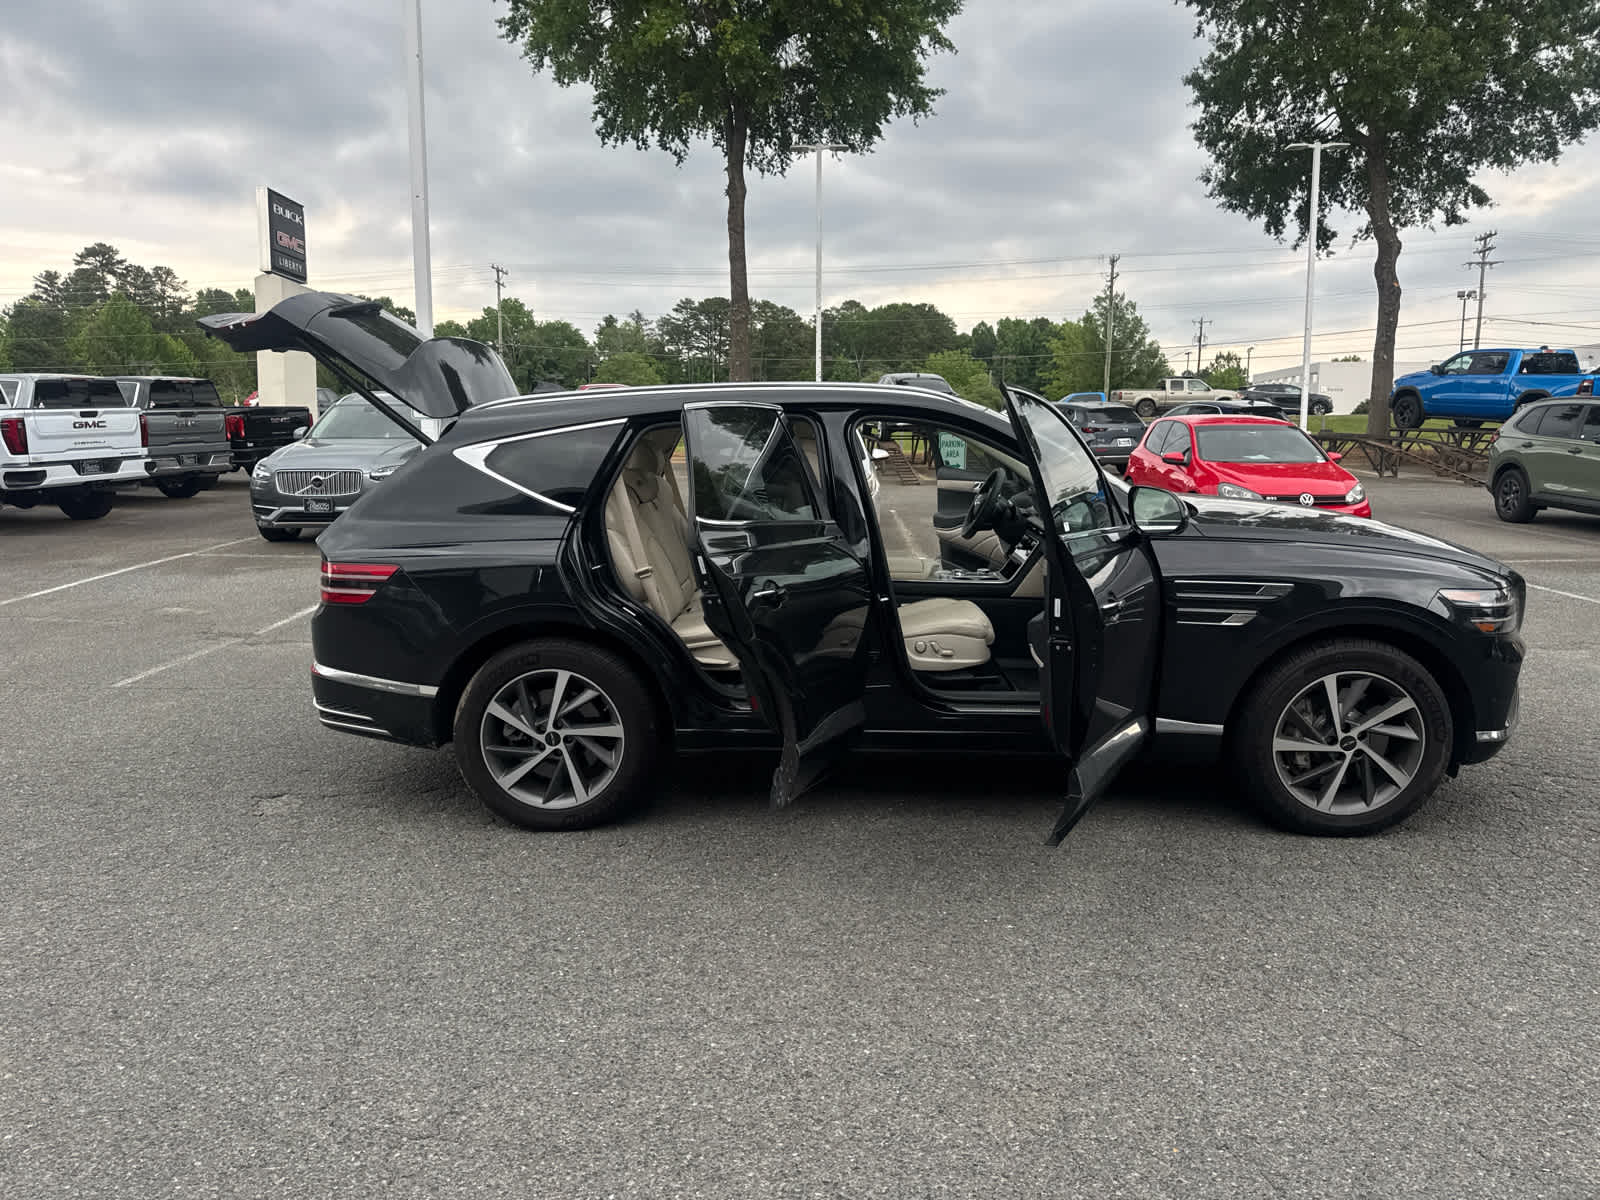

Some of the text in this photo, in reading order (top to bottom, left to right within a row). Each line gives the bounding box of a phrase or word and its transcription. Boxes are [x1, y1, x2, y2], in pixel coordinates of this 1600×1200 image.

[273, 203, 303, 226] BUICK
[276, 231, 305, 255] GMC
[279, 257, 303, 273] LIBERTY
[73, 420, 107, 429] GMC
[941, 440, 965, 448] PARKING
[946, 449, 960, 458] AREA
